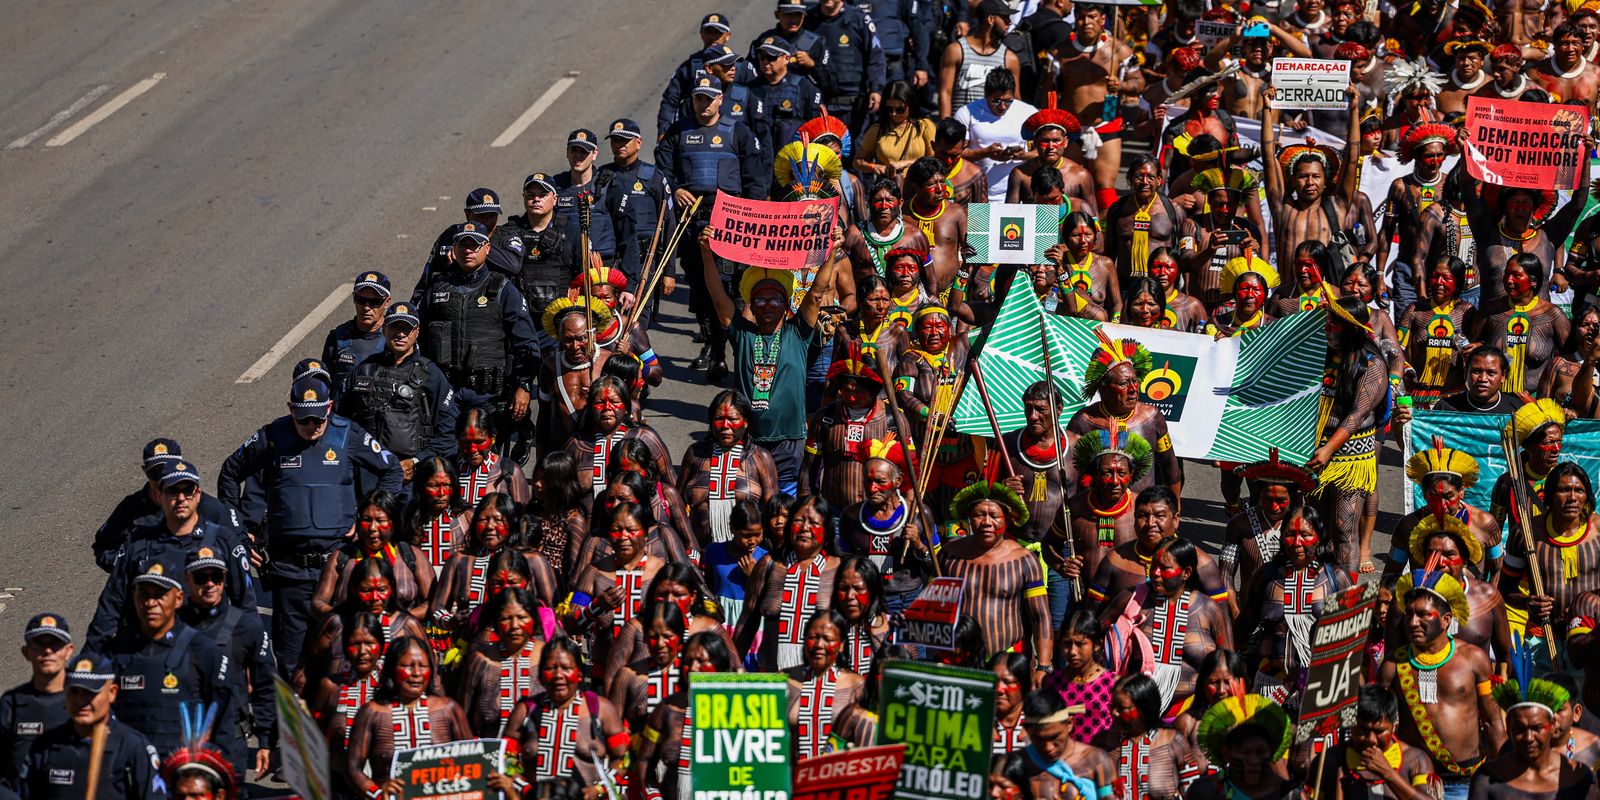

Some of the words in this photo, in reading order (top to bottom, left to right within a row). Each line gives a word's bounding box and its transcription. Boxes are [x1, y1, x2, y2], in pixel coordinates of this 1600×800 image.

[1275, 65, 1346, 73] DEMARCAÇÃO
[1274, 88, 1346, 102] CERRADO
[899, 620, 953, 646] PAMPAS
[1315, 607, 1372, 647] DEMARCAÇÃO
[909, 681, 965, 711] SEM
[695, 694, 784, 729] BRASIL
[884, 703, 983, 752] CLIMA
[695, 729, 785, 763] LIVRE
[728, 766, 754, 786] DE
[797, 754, 898, 783] FLORESTA
[897, 762, 984, 798] TRÓLEO
